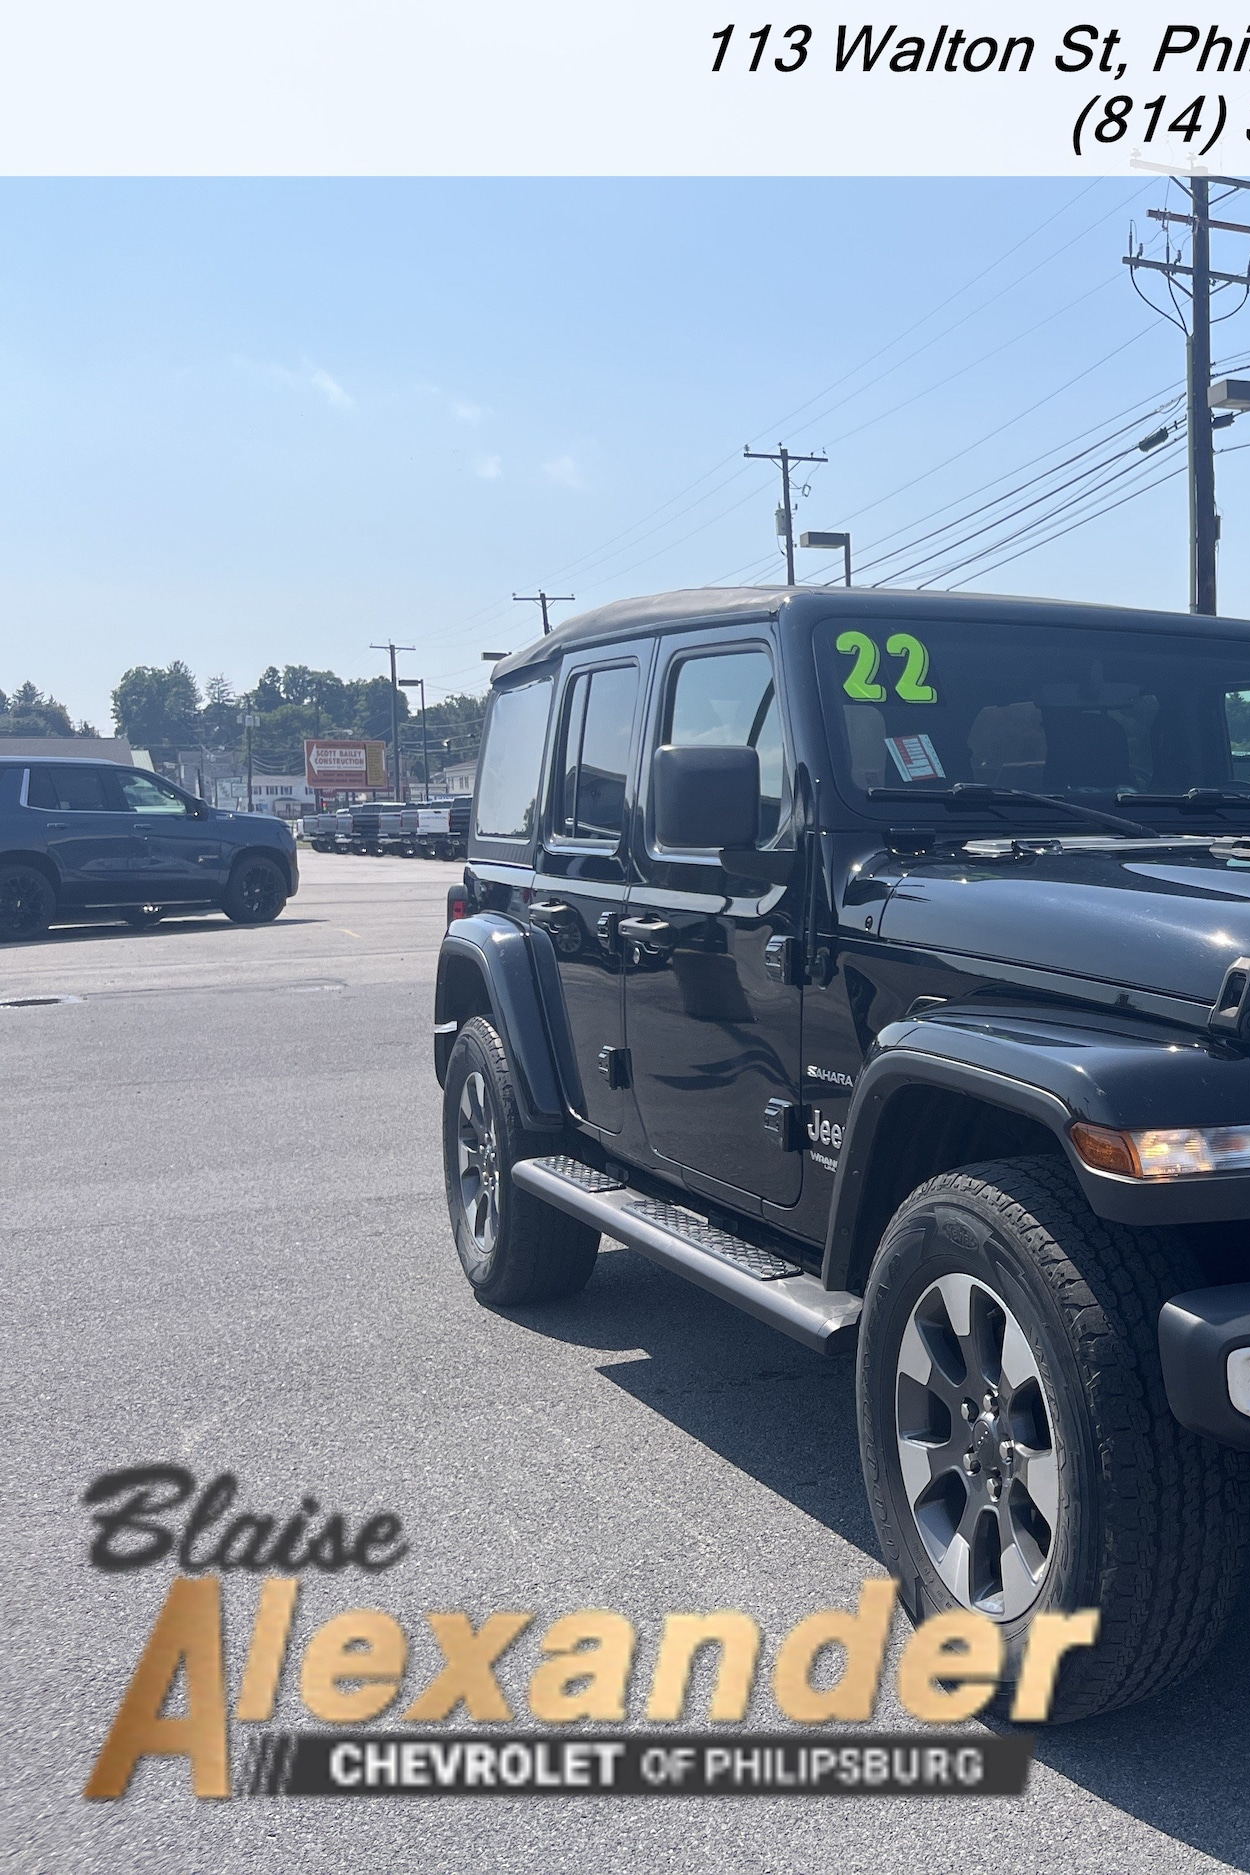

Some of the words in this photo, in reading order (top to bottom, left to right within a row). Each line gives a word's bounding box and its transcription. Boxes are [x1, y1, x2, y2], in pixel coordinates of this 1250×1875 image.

[836, 631, 938, 705] 22
[806, 1065, 854, 1088] SAHARA
[807, 1109, 845, 1150] Jee
